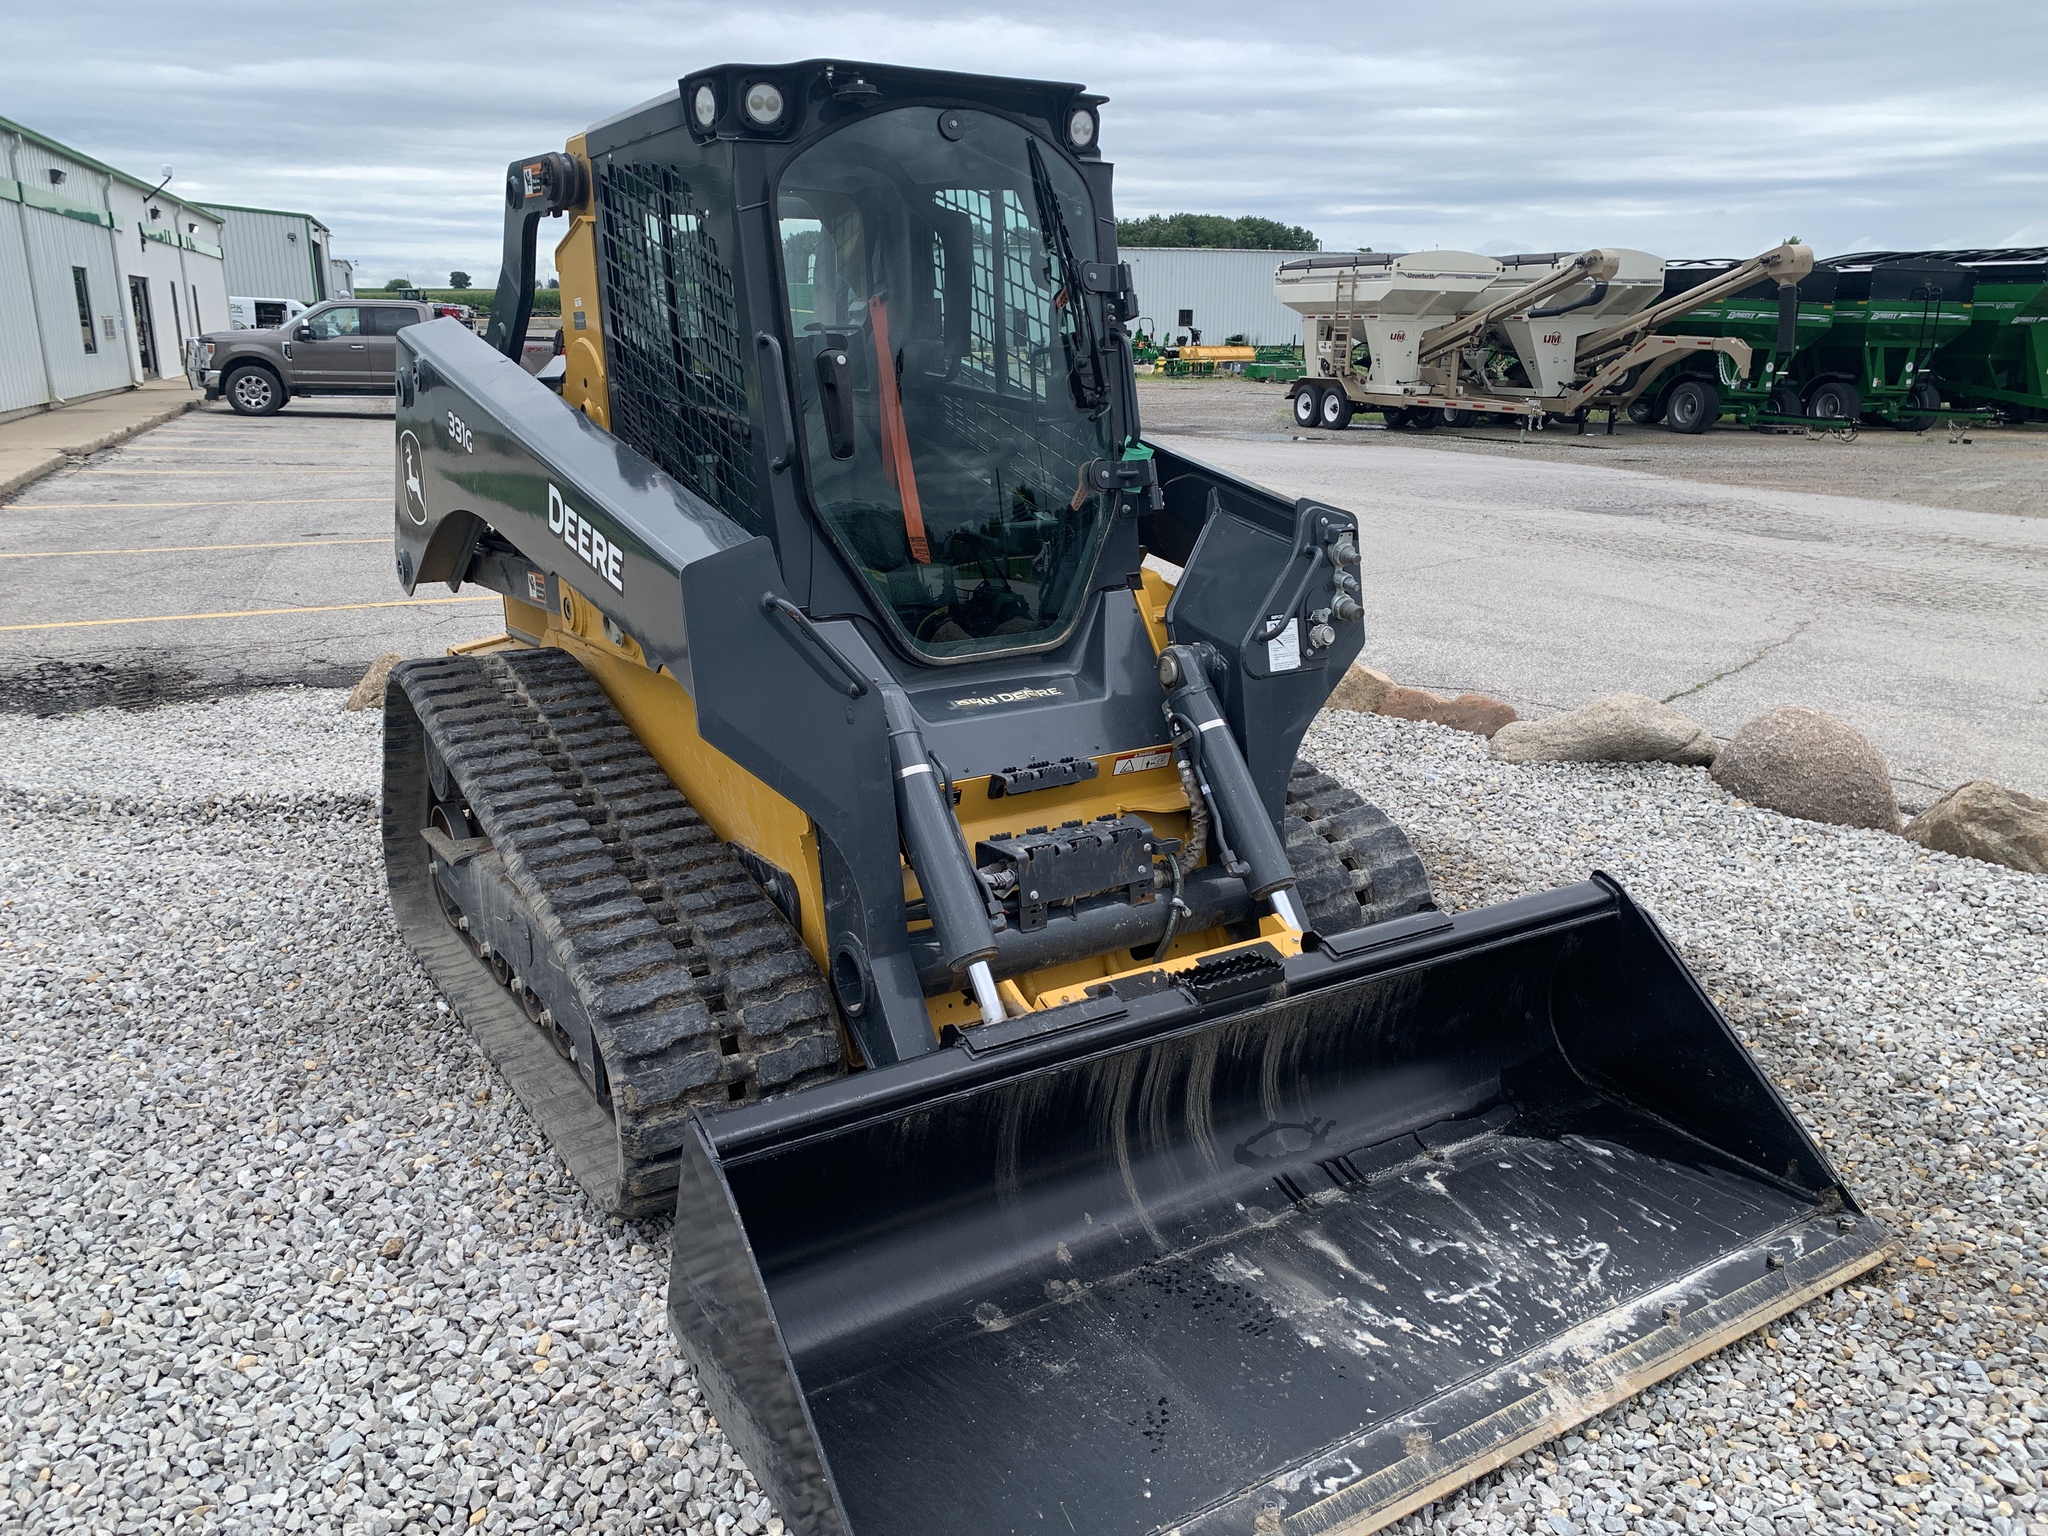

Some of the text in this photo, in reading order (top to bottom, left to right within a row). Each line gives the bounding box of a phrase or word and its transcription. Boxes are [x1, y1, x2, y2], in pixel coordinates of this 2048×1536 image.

[447, 410, 473, 454] 331G
[548, 482, 623, 592] DEERE
[997, 687, 1062, 703] DEERE
